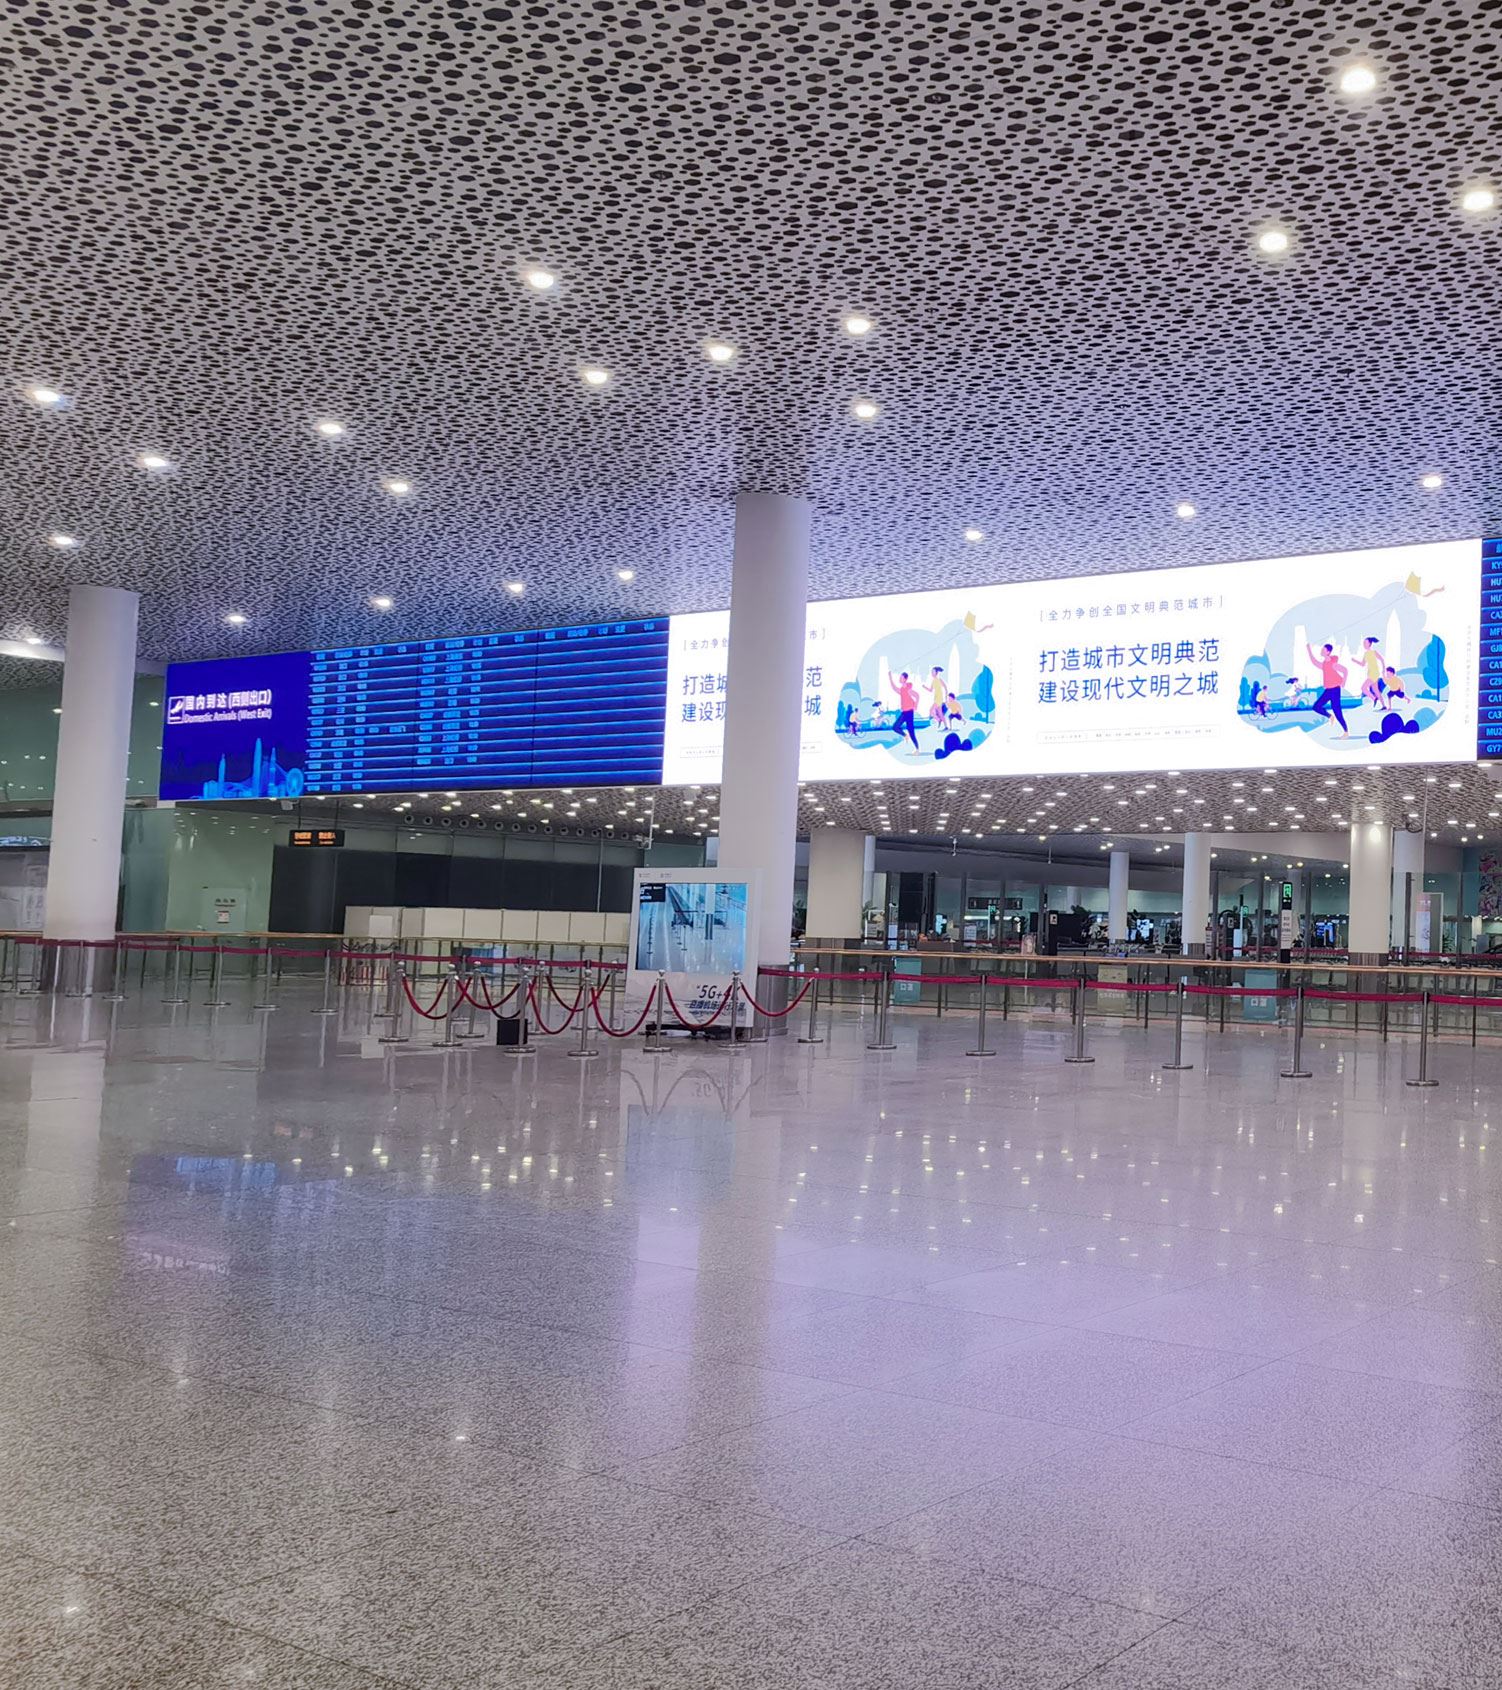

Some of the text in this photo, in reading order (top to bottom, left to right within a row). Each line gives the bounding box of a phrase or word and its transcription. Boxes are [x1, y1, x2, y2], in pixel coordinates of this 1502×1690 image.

[1039, 637, 1219, 673] 打造城市文明典范
[1038, 671, 1219, 704] 建设现代文明之城
